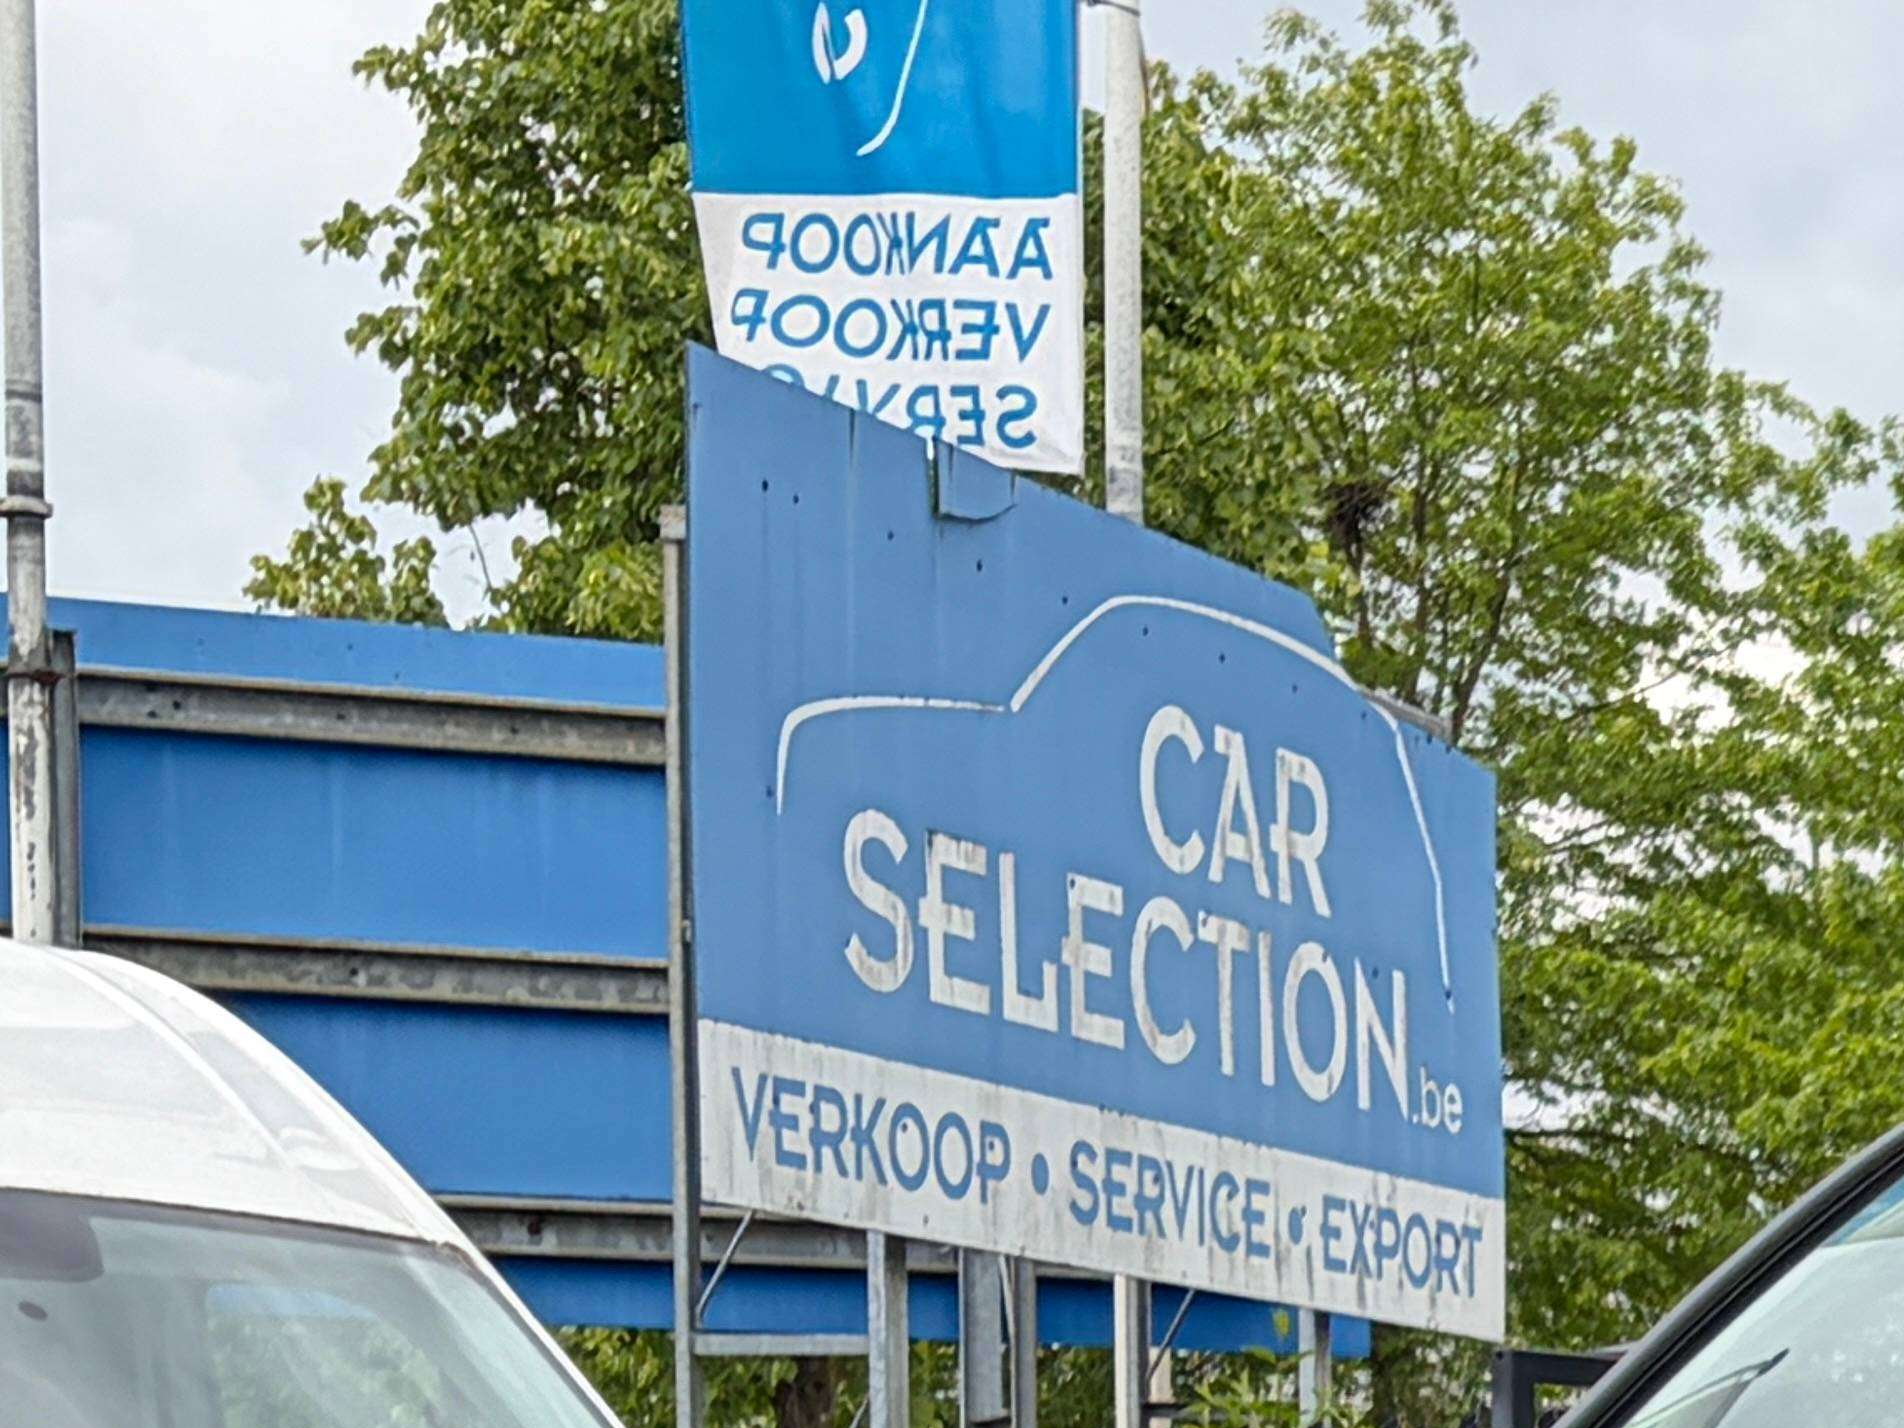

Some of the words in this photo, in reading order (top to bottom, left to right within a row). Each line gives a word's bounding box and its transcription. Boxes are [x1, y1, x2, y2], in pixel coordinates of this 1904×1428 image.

[1139, 704, 1333, 920] CAR
[731, 1066, 1012, 1206] VERKOOP
[1069, 1140, 1272, 1261] SERVICE
[1319, 1195, 1484, 1300] EXPORT
